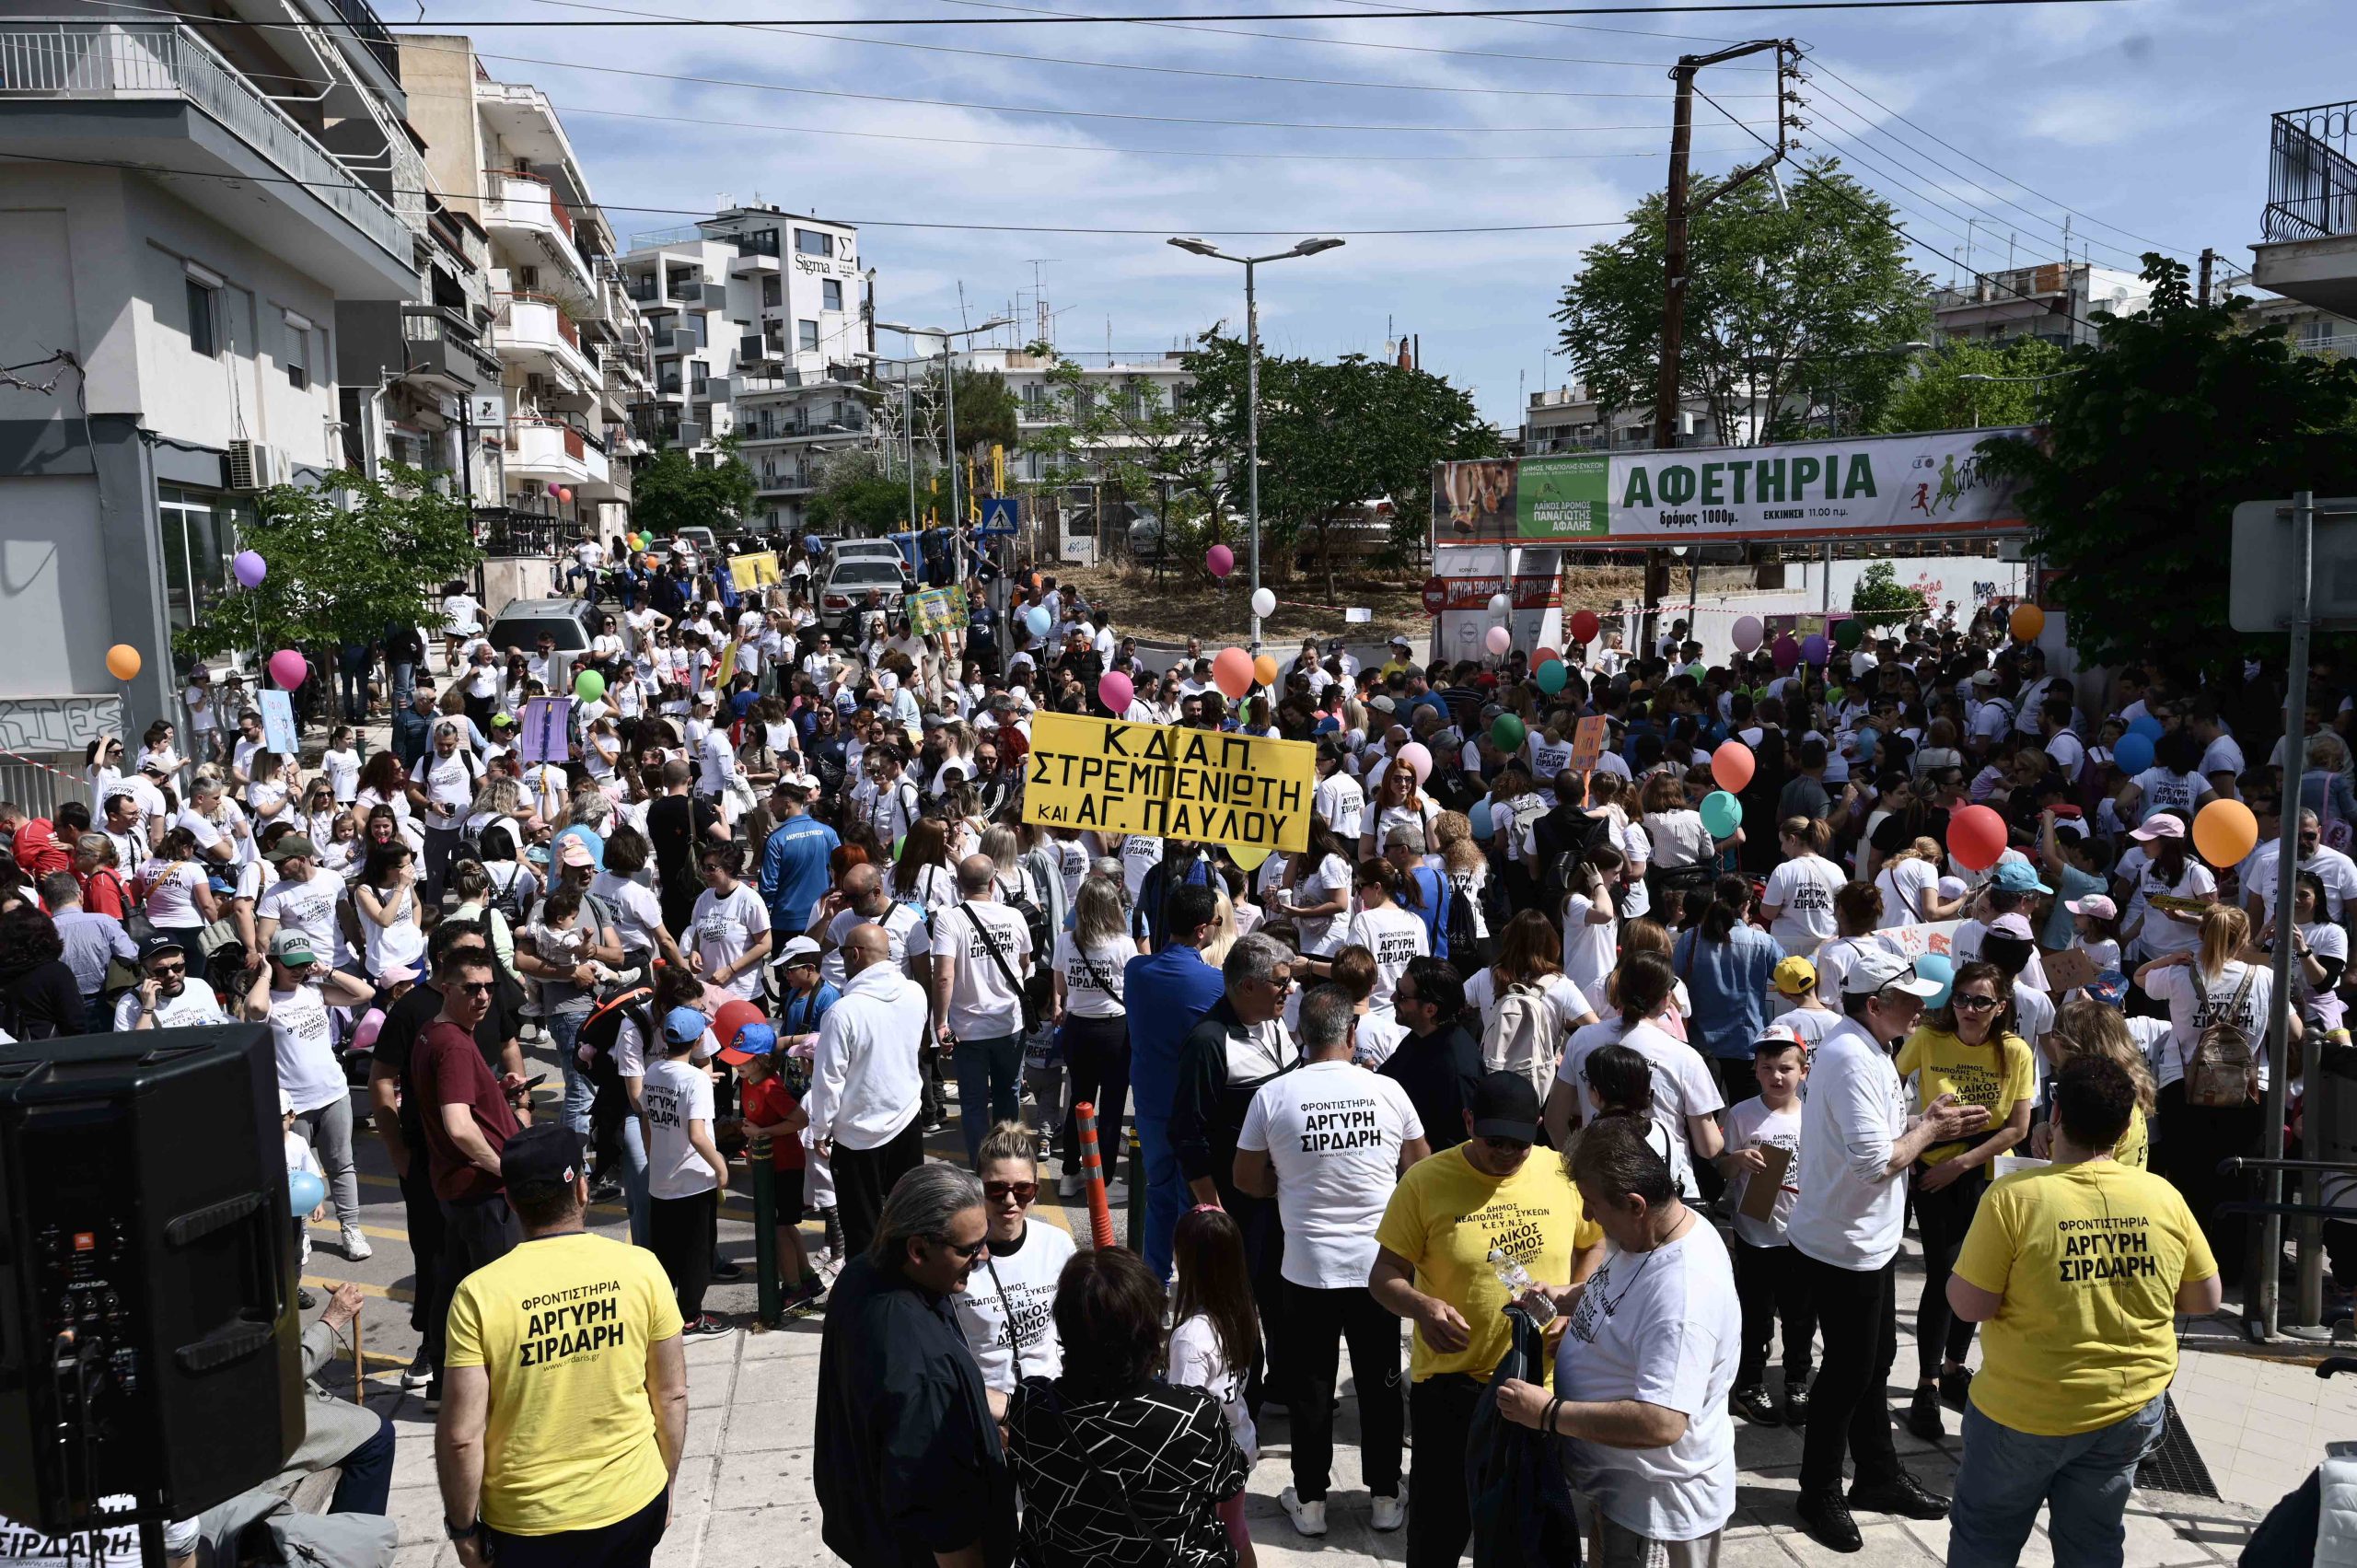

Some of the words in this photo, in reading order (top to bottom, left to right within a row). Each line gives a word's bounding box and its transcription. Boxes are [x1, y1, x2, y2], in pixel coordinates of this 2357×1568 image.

[839, 237, 853, 262] Σ
[795, 254, 830, 275] Sigma
[1622, 455, 1877, 507] ΑΦΕΤΗΡΙΑ
[1561, 501, 1591, 510] ΔΡΟΜΟΣ
[1533, 510, 1591, 521] ΠΑΝΑΓΙΩΤΗΣ
[1659, 511, 1698, 528] δρόμος
[1702, 508, 1738, 526] 1000μ.
[1763, 509, 1804, 520] ΕΚΚΙΝΗΣΗ
[1808, 508, 1830, 517] 11.00
[1552, 520, 1591, 531] ΑΦΑΛΗΣ
[1447, 581, 1472, 605] ΑΡΓΥΡΗ
[1474, 580, 1502, 596] ΣΙΡΔΑΡΗ
[1103, 724, 1256, 772] Κ.Δ.Α.Π.
[1538, 752, 1566, 761] ΑΡΓΥΡΗ
[1031, 750, 1301, 812] ΣΤΡΕΜΠΕΝΙΩΤΗ
[2157, 786, 2189, 797] ΑΡΓΥΡΗ
[2154, 795, 2189, 806] ΣΙΡΔΑΡΗ
[1075, 793, 1127, 829] ΑΓ.
[1143, 798, 1287, 845] ΠΑΥΛΟΥ
[1129, 839, 1155, 848] ΑΡΓΥΡΗ
[1125, 846, 1154, 857] ΣΙΡΔΑΡΗ
[147, 870, 180, 878] ΑΡΓΡΗ
[145, 878, 181, 888] ΣΙΡΑΡΗ
[703, 929, 727, 938] ΔΡΟΜΟΣ
[970, 923, 1013, 933] ΦΡΤΙΣΤΗΡΙΑ
[1377, 930, 1416, 939] ΦΡΟΝΤΙΣΤΗΡΙΑ
[972, 931, 1012, 945] ΑΡΥΡΗ
[1379, 937, 1415, 951] ΑΡΓΥΡΗ
[1068, 958, 1112, 966] ΦΡΟΝΣΤΗΡΙΑ
[1376, 949, 1417, 964] ΣΙΡΔΑΡΗ
[1067, 976, 1113, 988] ΣΙΡΔΑΗ
[2197, 1002, 2251, 1015] ΑΡΓΡΗ
[2192, 1015, 2254, 1028] ΣΙΡΗ
[1930, 1065, 1970, 1075] ΝΕΑΠΟΛΗΣ
[1980, 1071, 2011, 1079] ΣΥΚΝ
[1950, 1074, 1988, 1084] Κ.Ε.Υ.Ν.Σ.
[1956, 1082, 2000, 1094] ΛΑΪΚΟΣ
[647, 1095, 678, 1112] ΡΓΥΡΗ
[1953, 1091, 2002, 1103] ΔΡΟΜΟΣ
[1300, 1098, 1376, 1112] ΦΡΟΝΤΙΣΤΗΡΙΑ
[1306, 1110, 1376, 1132] ΑΡΓΥΡΗ
[1300, 1129, 1381, 1152] ΣΙΡΔΑΡΗ
[1318, 1149, 1365, 1159] www.sirdaris.gr
[1486, 1202, 1518, 1214] ΔΗΜΟΣ
[1455, 1211, 1504, 1224] ΝΕΑΠΟΛΗΣ
[1515, 1208, 1550, 1218] ΣΥΚΕΩΝ
[1481, 1218, 1527, 1230] Κ.Ε.Υ.Ν.Σ.
[2058, 1216, 2150, 1232] ΦΡΟΝΤΙΣΤΗΡΙΑ
[1490, 1223, 1539, 1249] ΛΑΪΚΟΣ
[1487, 1234, 1545, 1262] ΔΟΜΟΣ
[2065, 1232, 2148, 1256] ΑΡΓΥΡΗ
[2059, 1256, 2156, 1282] ΣΙΡΔΑΡΗ
[2081, 1281, 2135, 1290] www.sirdaris.gr
[521, 1280, 621, 1311] ΦΡΟΝΤΙΣΤΗΡΙΑ
[964, 1294, 1013, 1307] ΝΕΑΠΟΛΣ
[1025, 1283, 1058, 1296] ΣΥΚΕΩΝ
[528, 1297, 617, 1339] ΑΡΓΥΡΗ
[1000, 1300, 1050, 1331] ΛΑΪΚΟΣ
[519, 1322, 624, 1367] ΣΙΡΔΑΡΗ
[543, 1353, 600, 1372] www.sirdaris.gr
